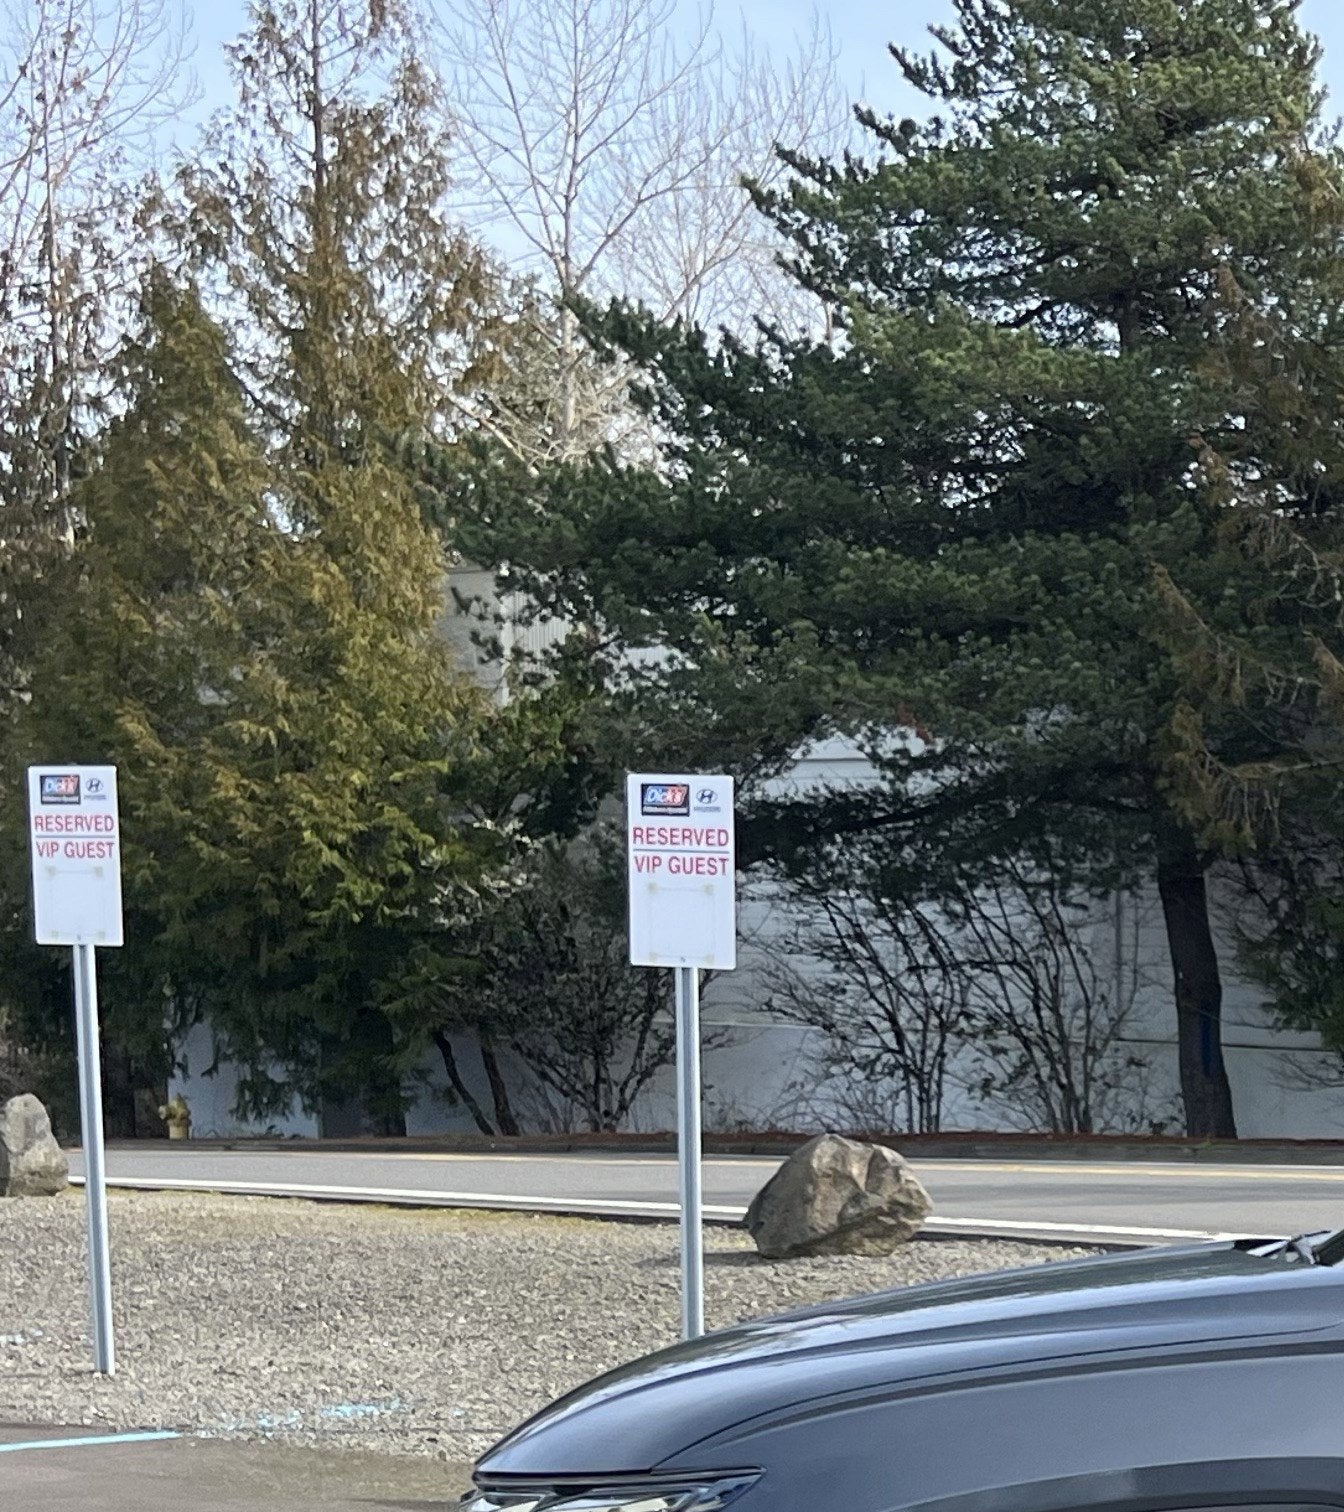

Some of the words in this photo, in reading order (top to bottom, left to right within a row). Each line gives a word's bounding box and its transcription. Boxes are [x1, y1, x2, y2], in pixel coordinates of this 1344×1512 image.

[34, 814, 115, 832] RESERVED
[632, 826, 730, 847] RESERVED
[36, 842, 59, 858] VIP
[64, 842, 115, 858] GUEST
[634, 856, 662, 873] VIP
[668, 857, 729, 875] GUEST
